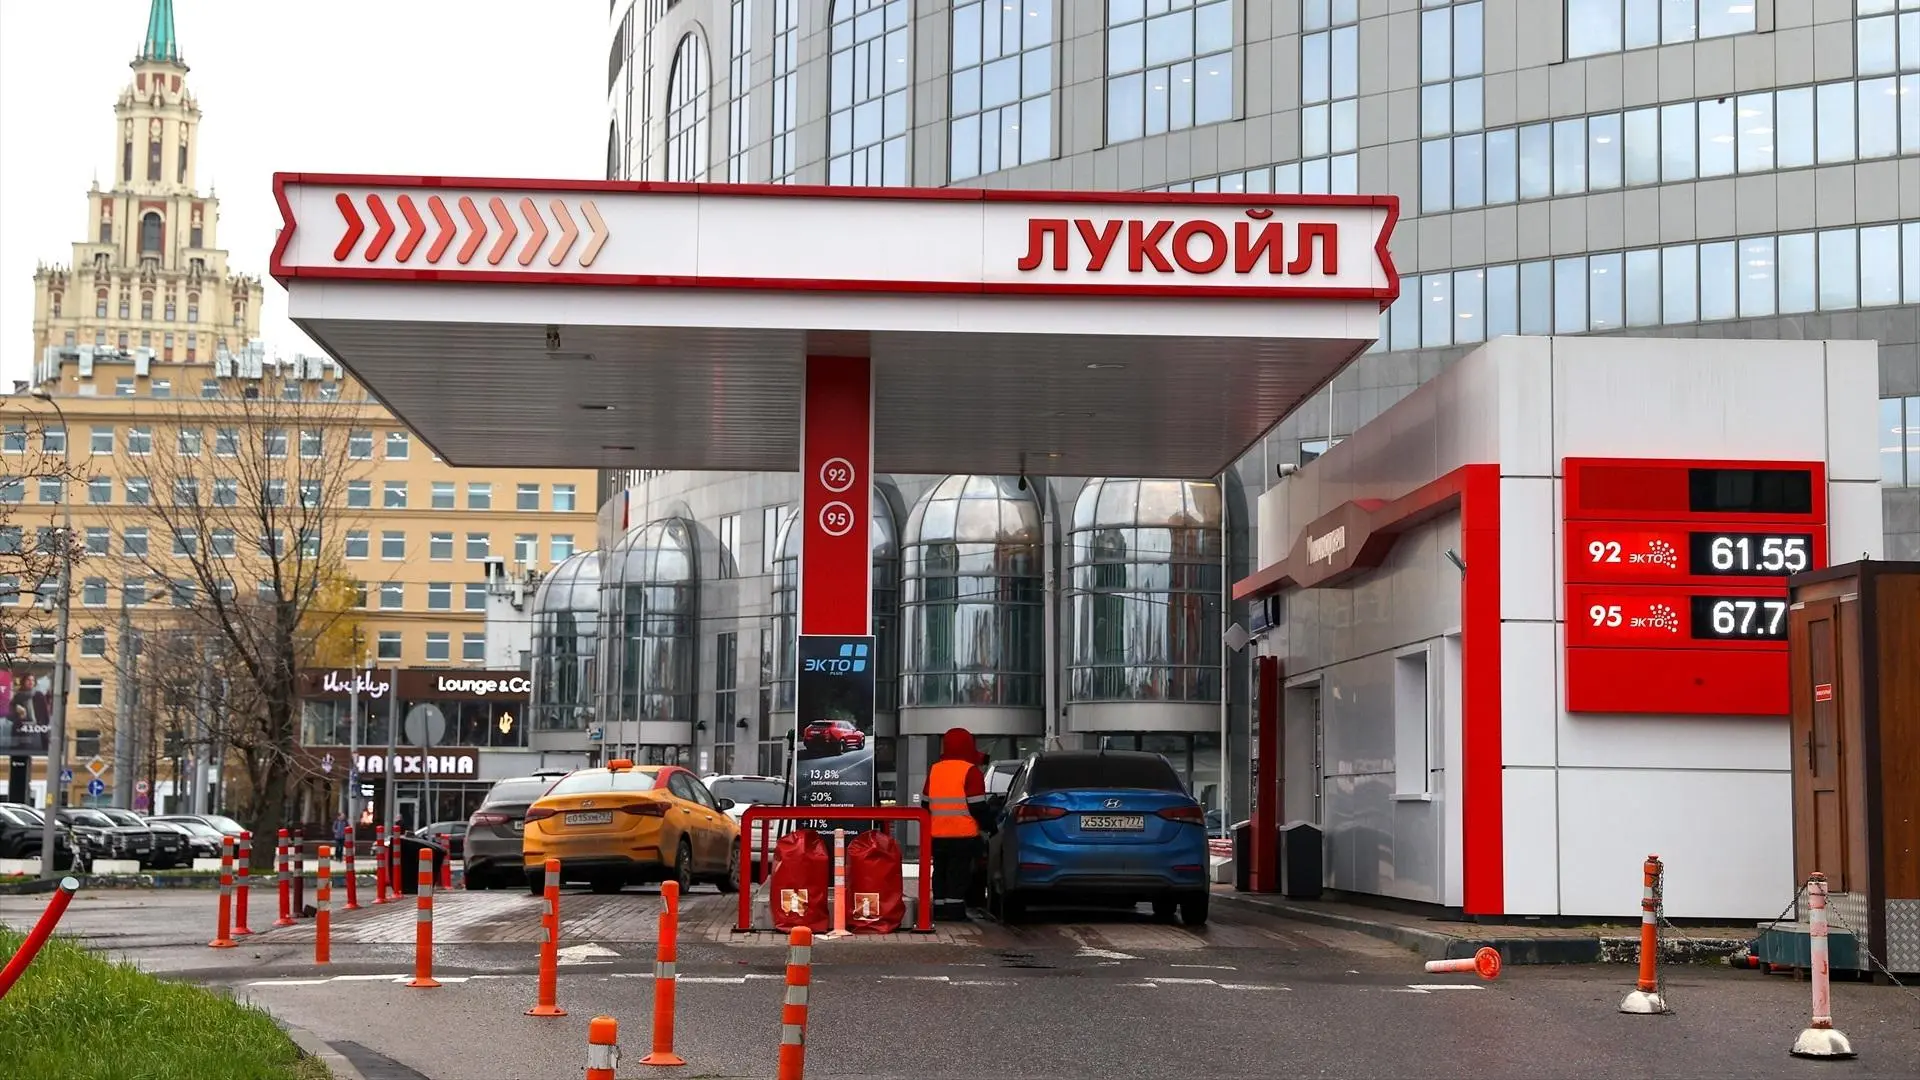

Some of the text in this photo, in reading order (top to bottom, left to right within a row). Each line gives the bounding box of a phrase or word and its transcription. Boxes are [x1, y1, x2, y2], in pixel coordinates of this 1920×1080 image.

[1018, 208, 1338, 275] ЛУКОЙЛ
[828, 468, 846, 481] 92
[827, 512, 846, 526] 95
[1588, 537, 1807, 571] 92 ЭКТО 61.55
[1589, 604, 1622, 627] 95
[1630, 617, 1665, 627] ЭКТО
[804, 658, 851, 672] ЭКТО
[438, 676, 497, 695] Lounge
